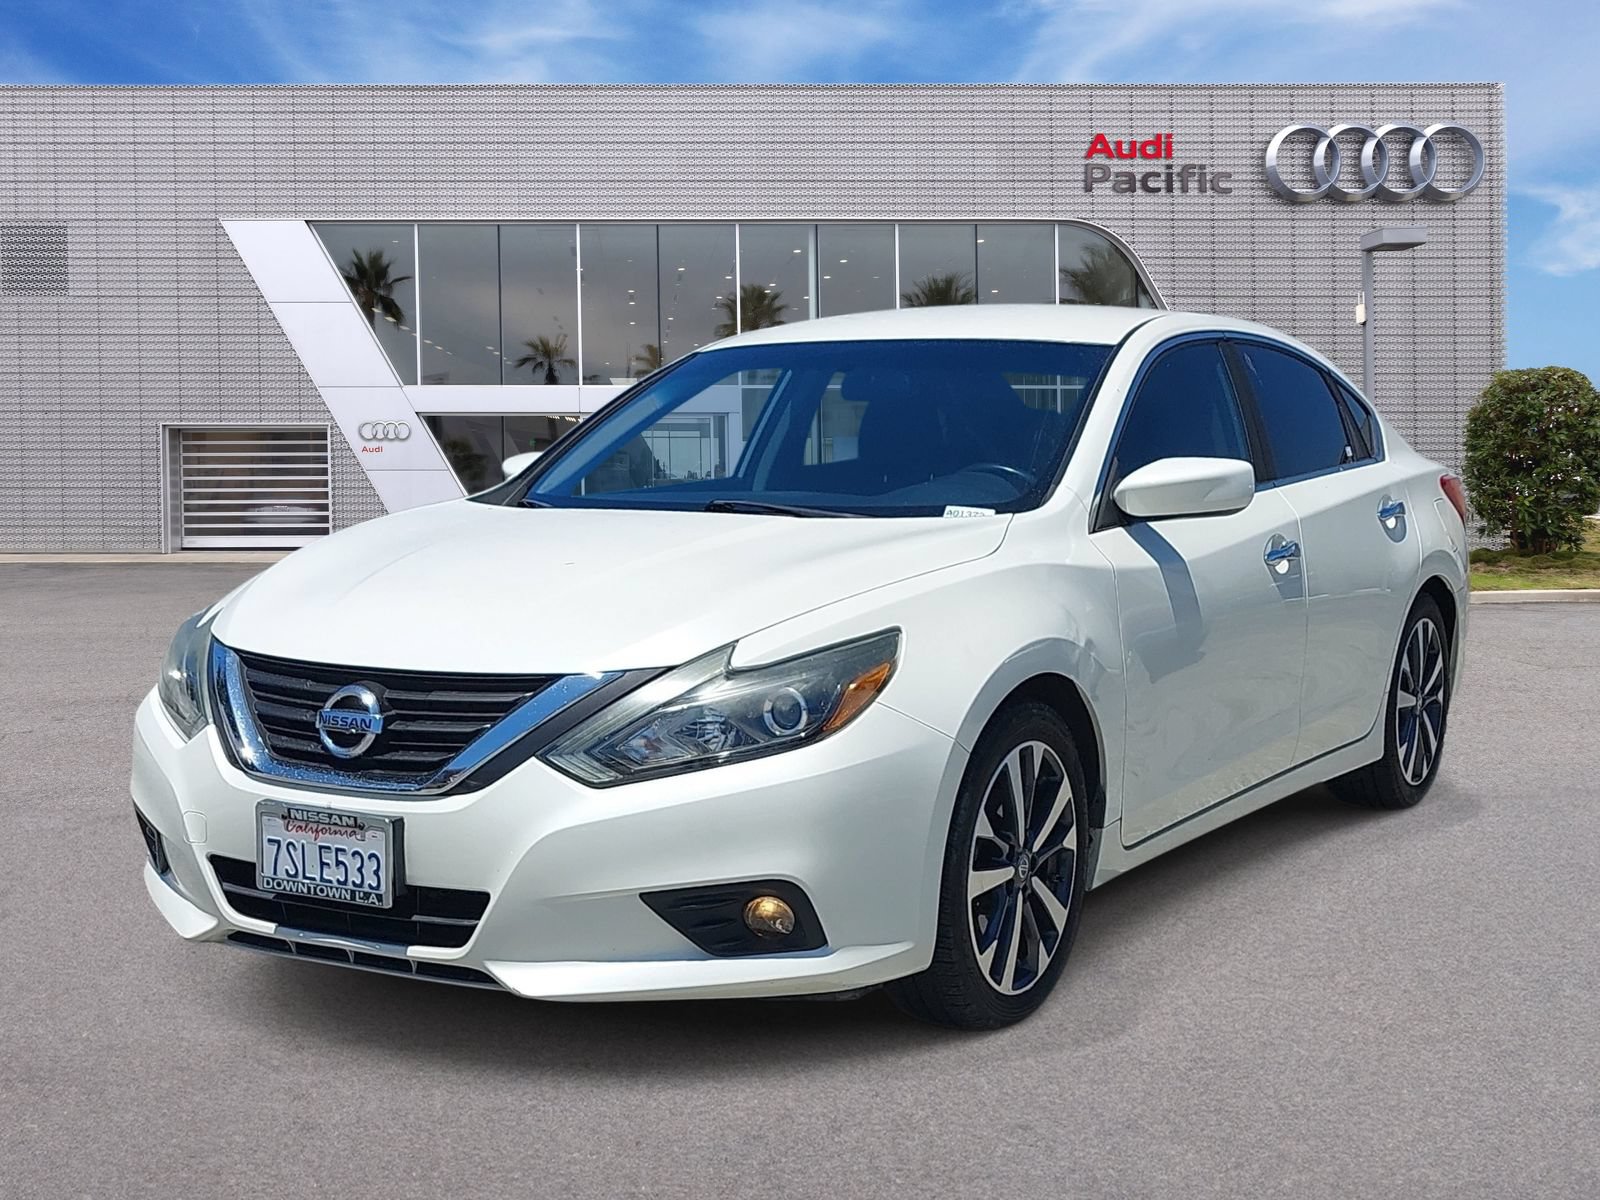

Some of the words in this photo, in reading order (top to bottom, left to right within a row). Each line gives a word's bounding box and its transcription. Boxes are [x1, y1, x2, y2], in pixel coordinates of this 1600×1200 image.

[1085, 133, 1174, 159] Audi
[1084, 163, 1233, 194] Pacific
[319, 712, 372, 729] NISSAN
[285, 820, 366, 842] California
[289, 809, 355, 827] NISSAN
[267, 838, 381, 891] 7SLE533
[263, 878, 351, 901] DOWNTOWN
[355, 891, 383, 906] L.A.
